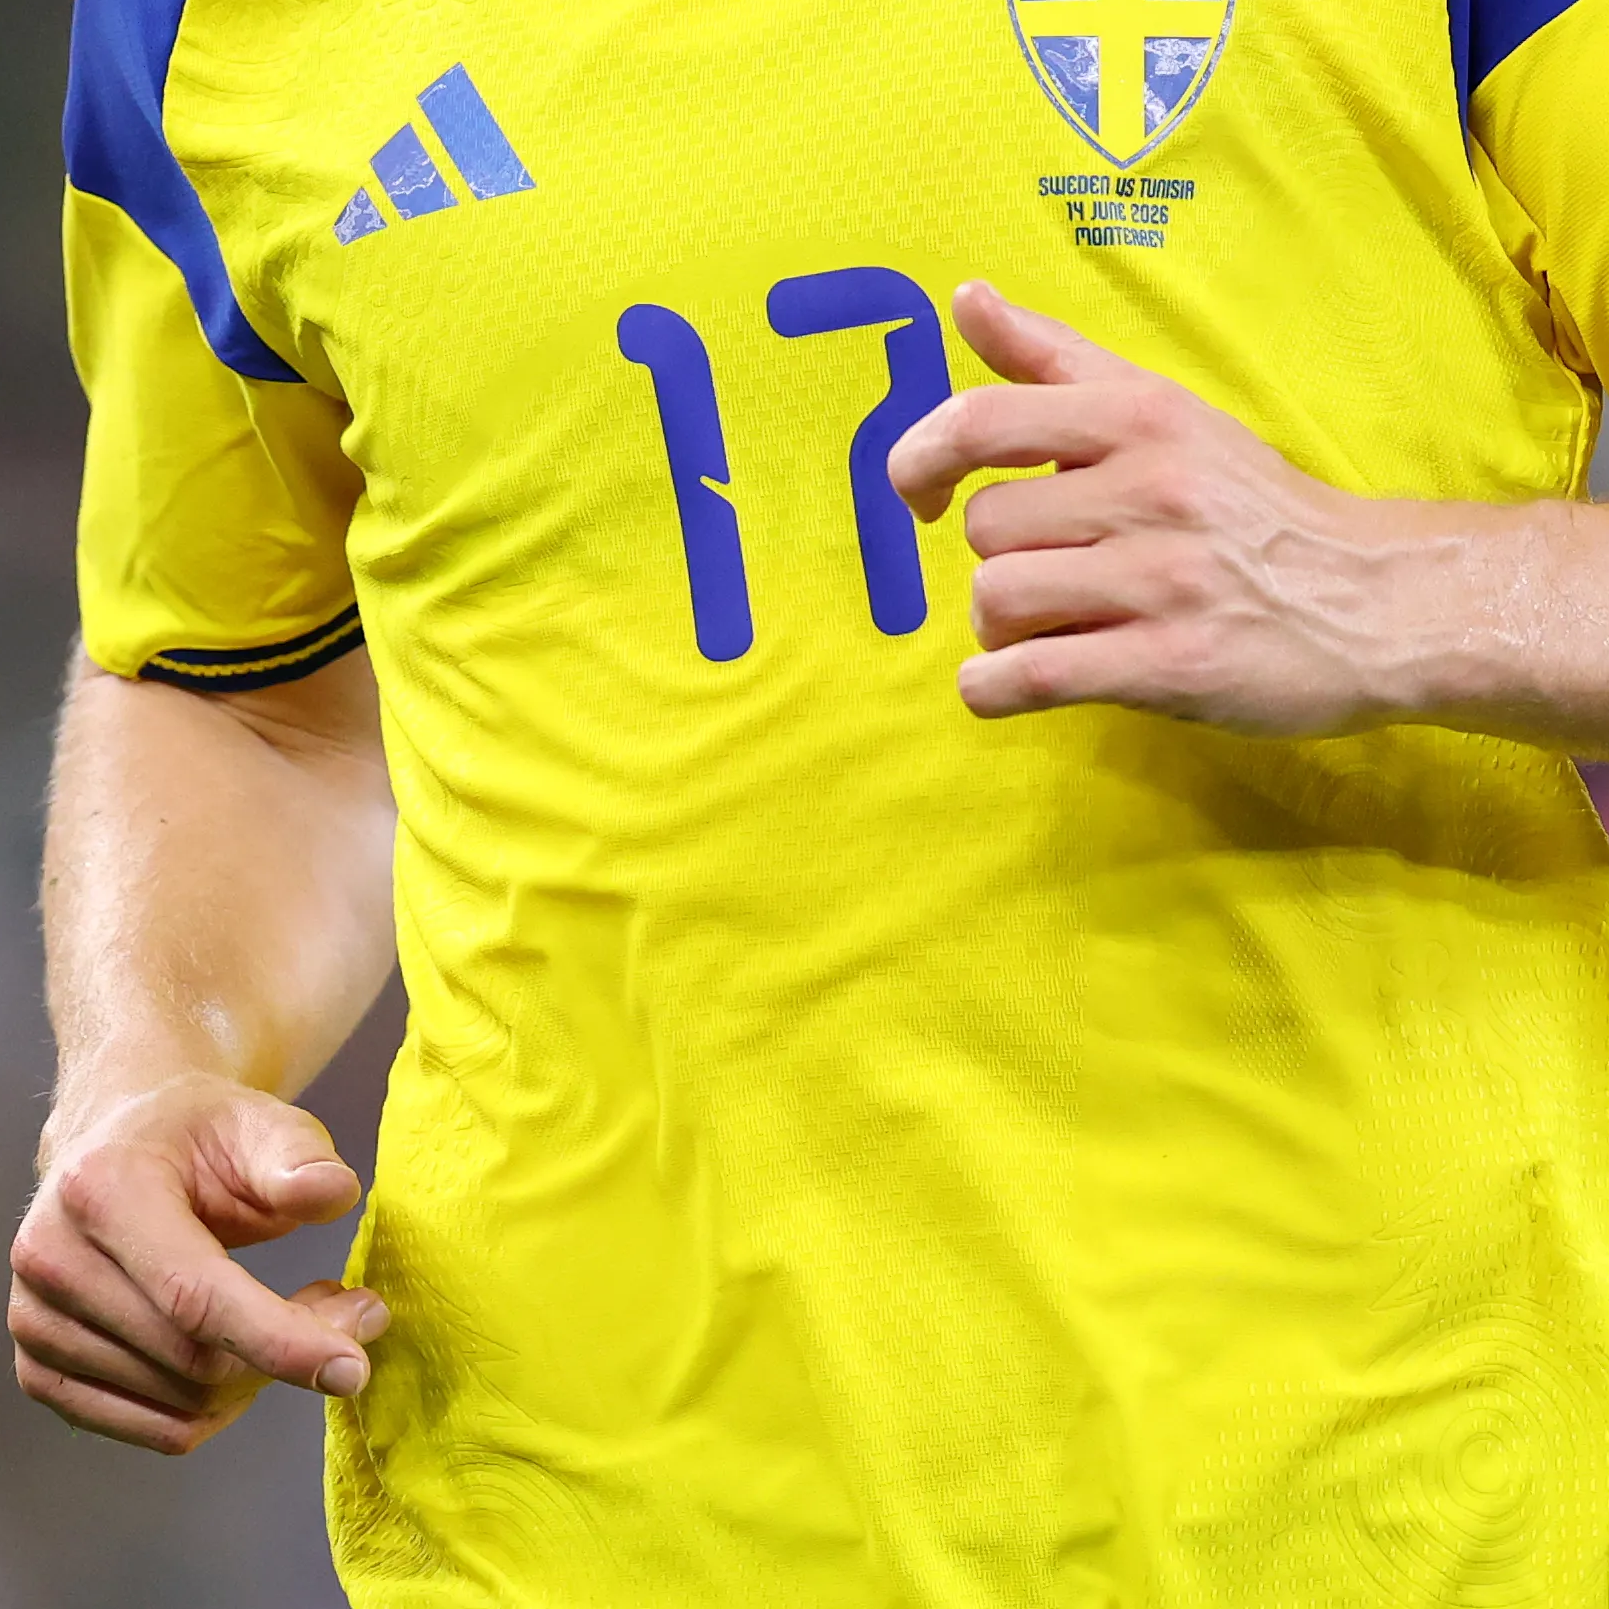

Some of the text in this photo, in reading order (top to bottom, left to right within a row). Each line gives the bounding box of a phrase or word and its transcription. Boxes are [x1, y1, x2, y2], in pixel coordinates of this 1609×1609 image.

[1038, 175, 1110, 196] SWEDEN
[1140, 178, 1195, 200] TUNISIA
[1066, 201, 1169, 224] 14 JUNE 2026
[1075, 226, 1165, 248] MONTERREY
[617, 267, 953, 662] 17
